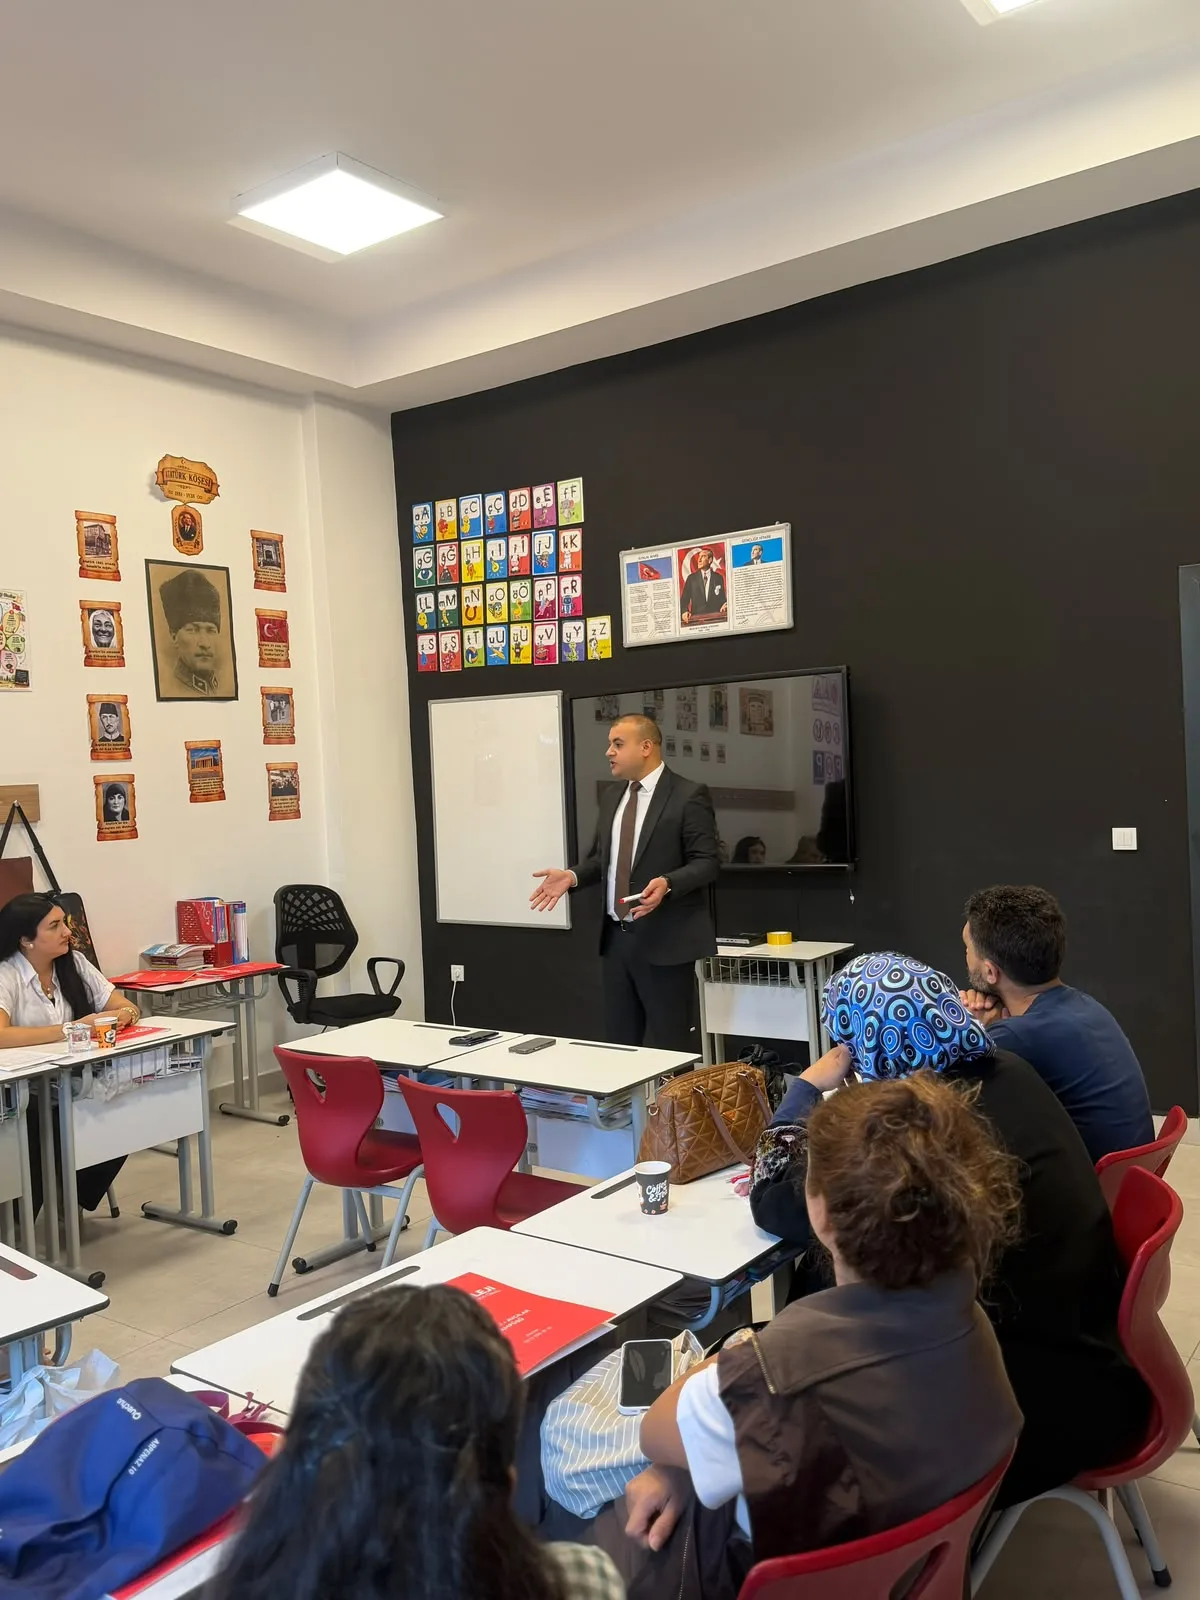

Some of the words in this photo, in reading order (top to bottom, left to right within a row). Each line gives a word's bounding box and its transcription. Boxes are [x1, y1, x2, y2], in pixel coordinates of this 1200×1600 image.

[646, 1180, 667, 1195] Coffee
[134, 1438, 160, 1467] ARPENAZ
[128, 1465, 137, 1475] 10
